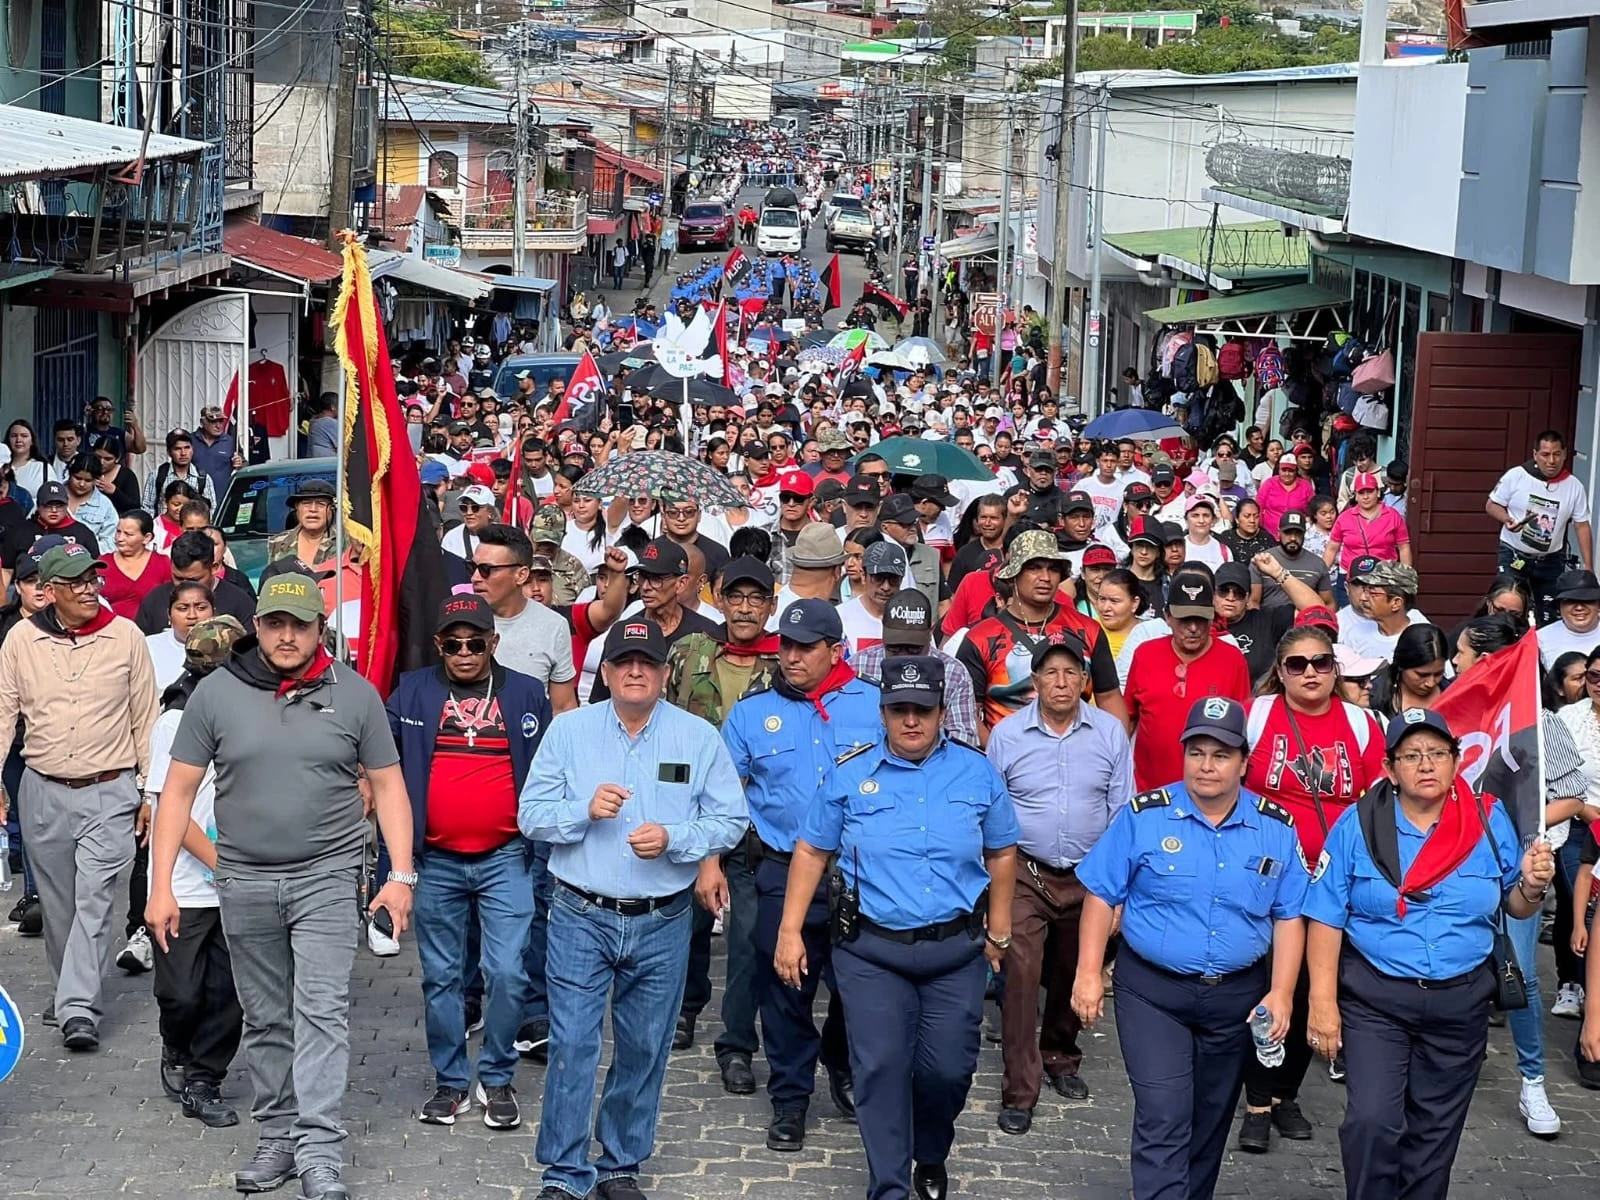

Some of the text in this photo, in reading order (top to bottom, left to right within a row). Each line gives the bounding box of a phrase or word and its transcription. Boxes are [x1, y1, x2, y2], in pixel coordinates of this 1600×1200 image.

[269, 583, 306, 597] FSLN
[444, 600, 479, 615] FSLN
[626, 628, 646, 637] FSLN
[439, 696, 507, 732] FSLN
[1269, 739, 1285, 785] 1979
[1338, 746, 1352, 794] FSLN
